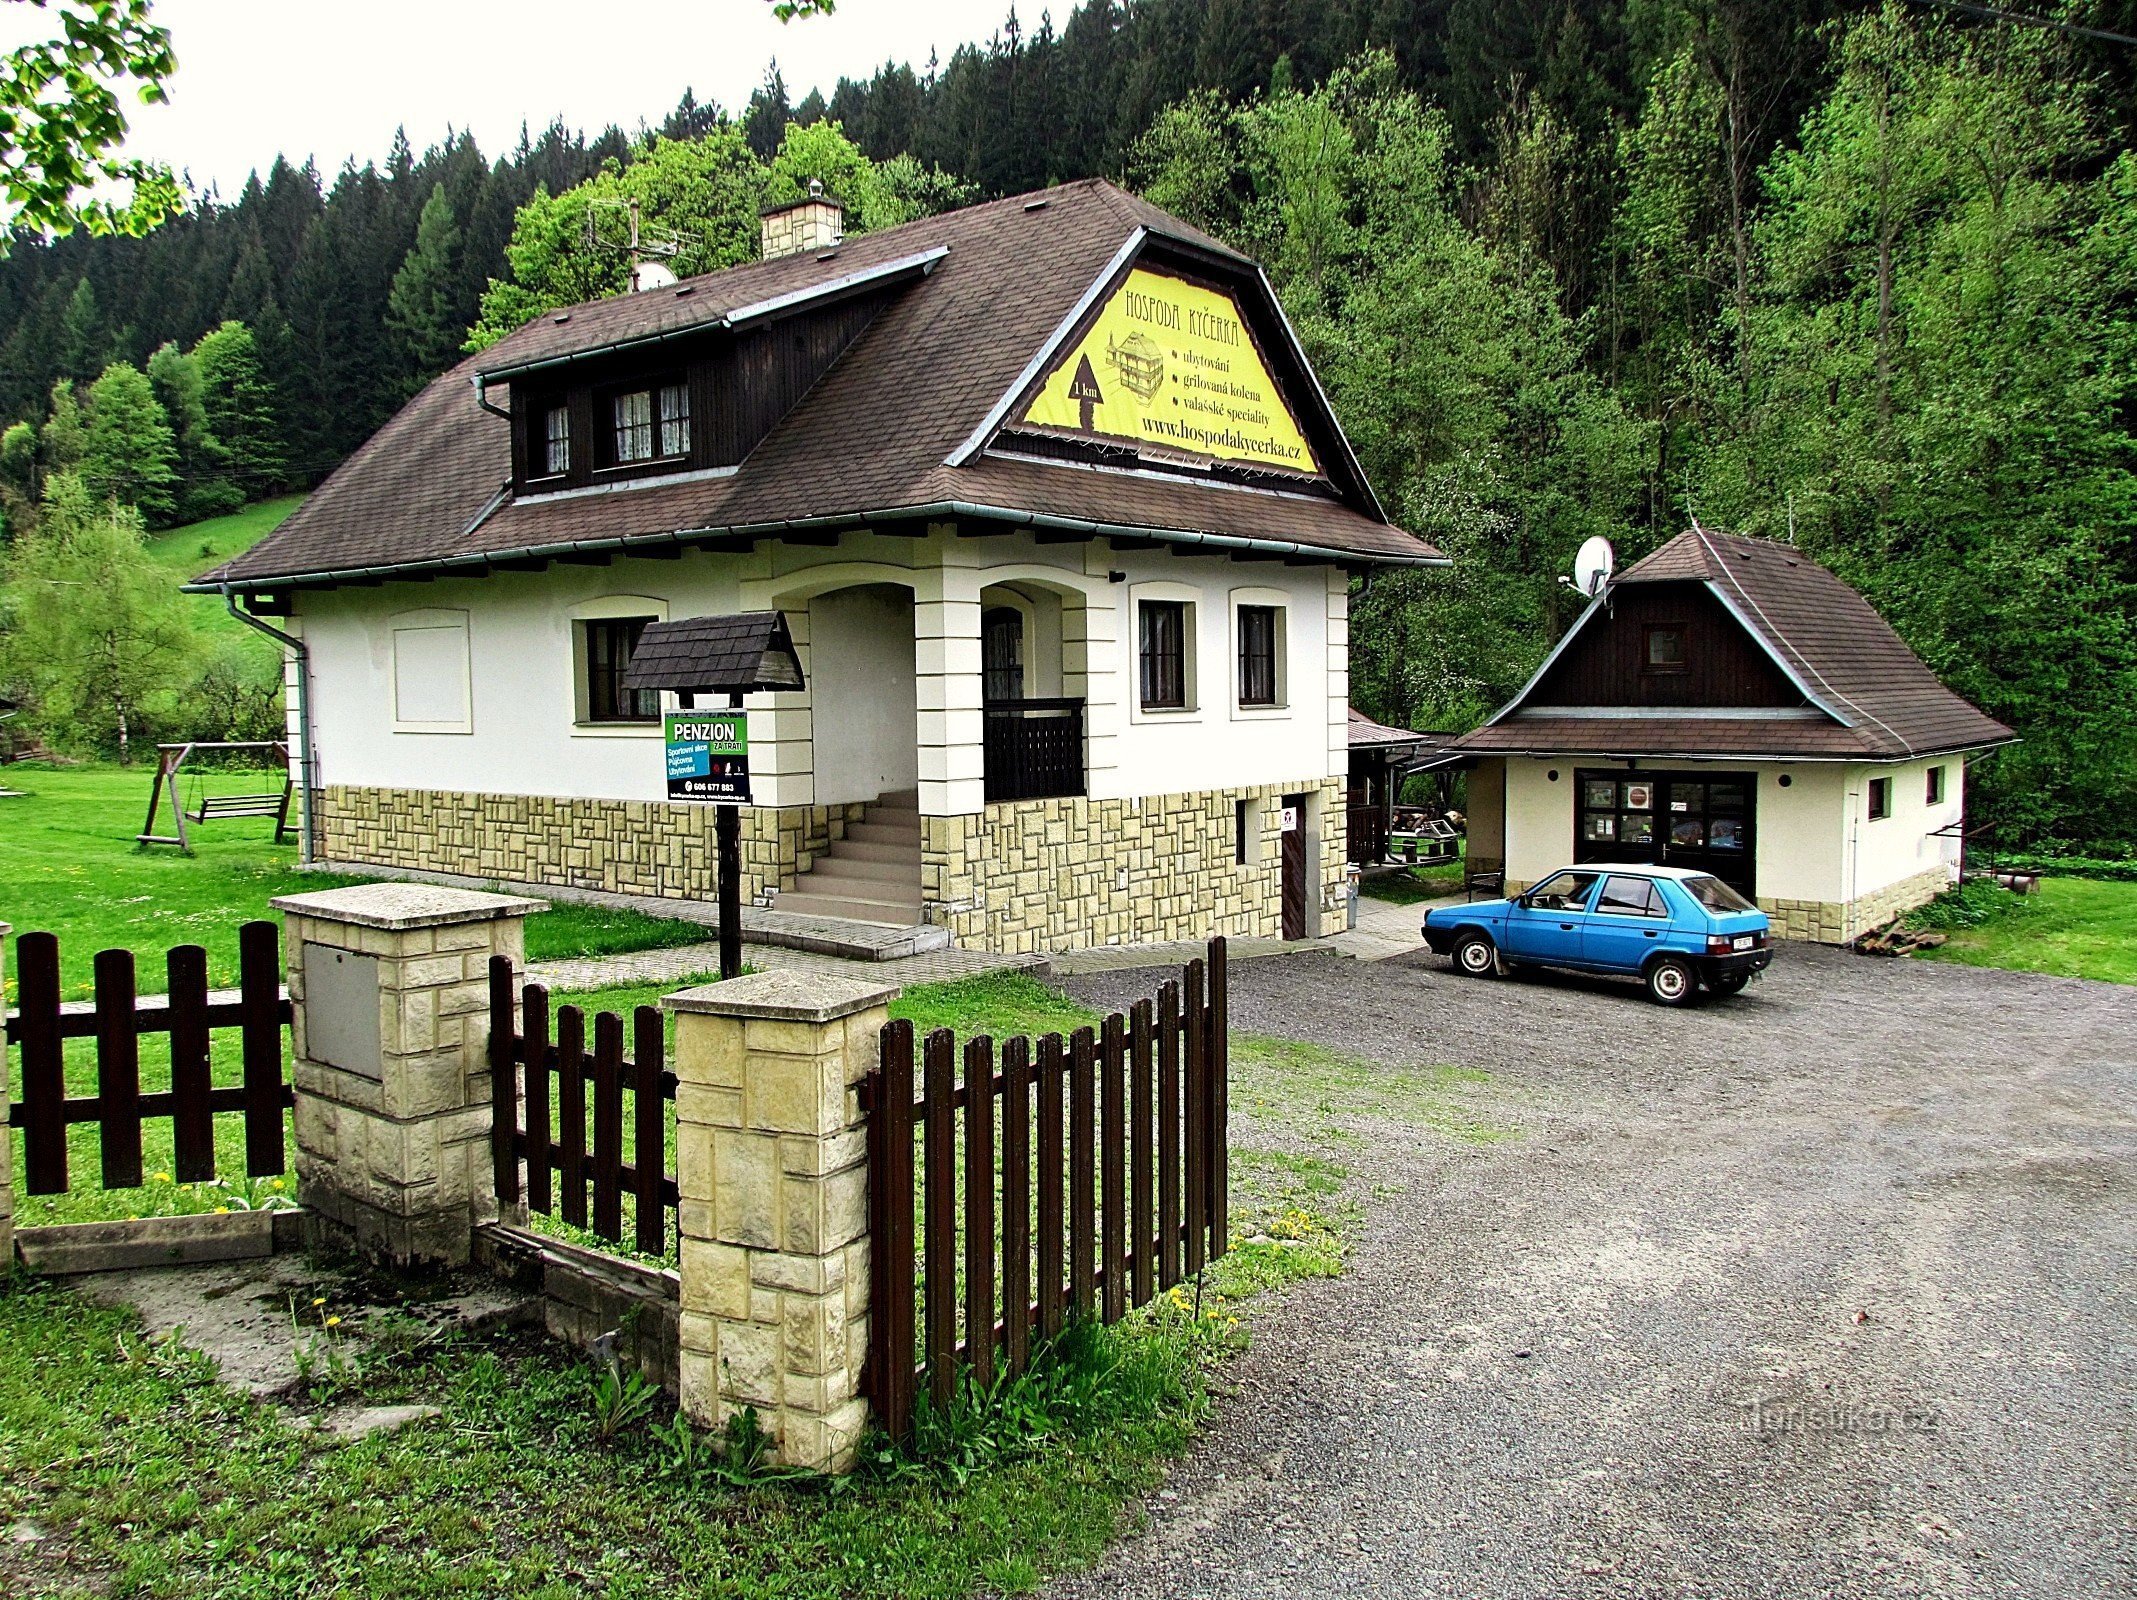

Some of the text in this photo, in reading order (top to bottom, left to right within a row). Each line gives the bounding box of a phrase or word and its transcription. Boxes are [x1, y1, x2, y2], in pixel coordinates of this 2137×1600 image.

[1126, 290, 1239, 347] HOSPODA KYČERKA
[1183, 349, 1230, 373] ubytování
[1074, 381, 1098, 398] 1 km
[1183, 374, 1261, 403] grilovaná kolena
[1183, 396, 1270, 429] valašské speciality
[1142, 417, 1301, 460] www.hospodakycerka.cz
[674, 723, 735, 741] PENZION
[668, 744, 708, 757] Sportovní akce
[714, 742, 723, 751] ZA
[693, 783, 706, 791] 606
[721, 783, 734, 792] 883
